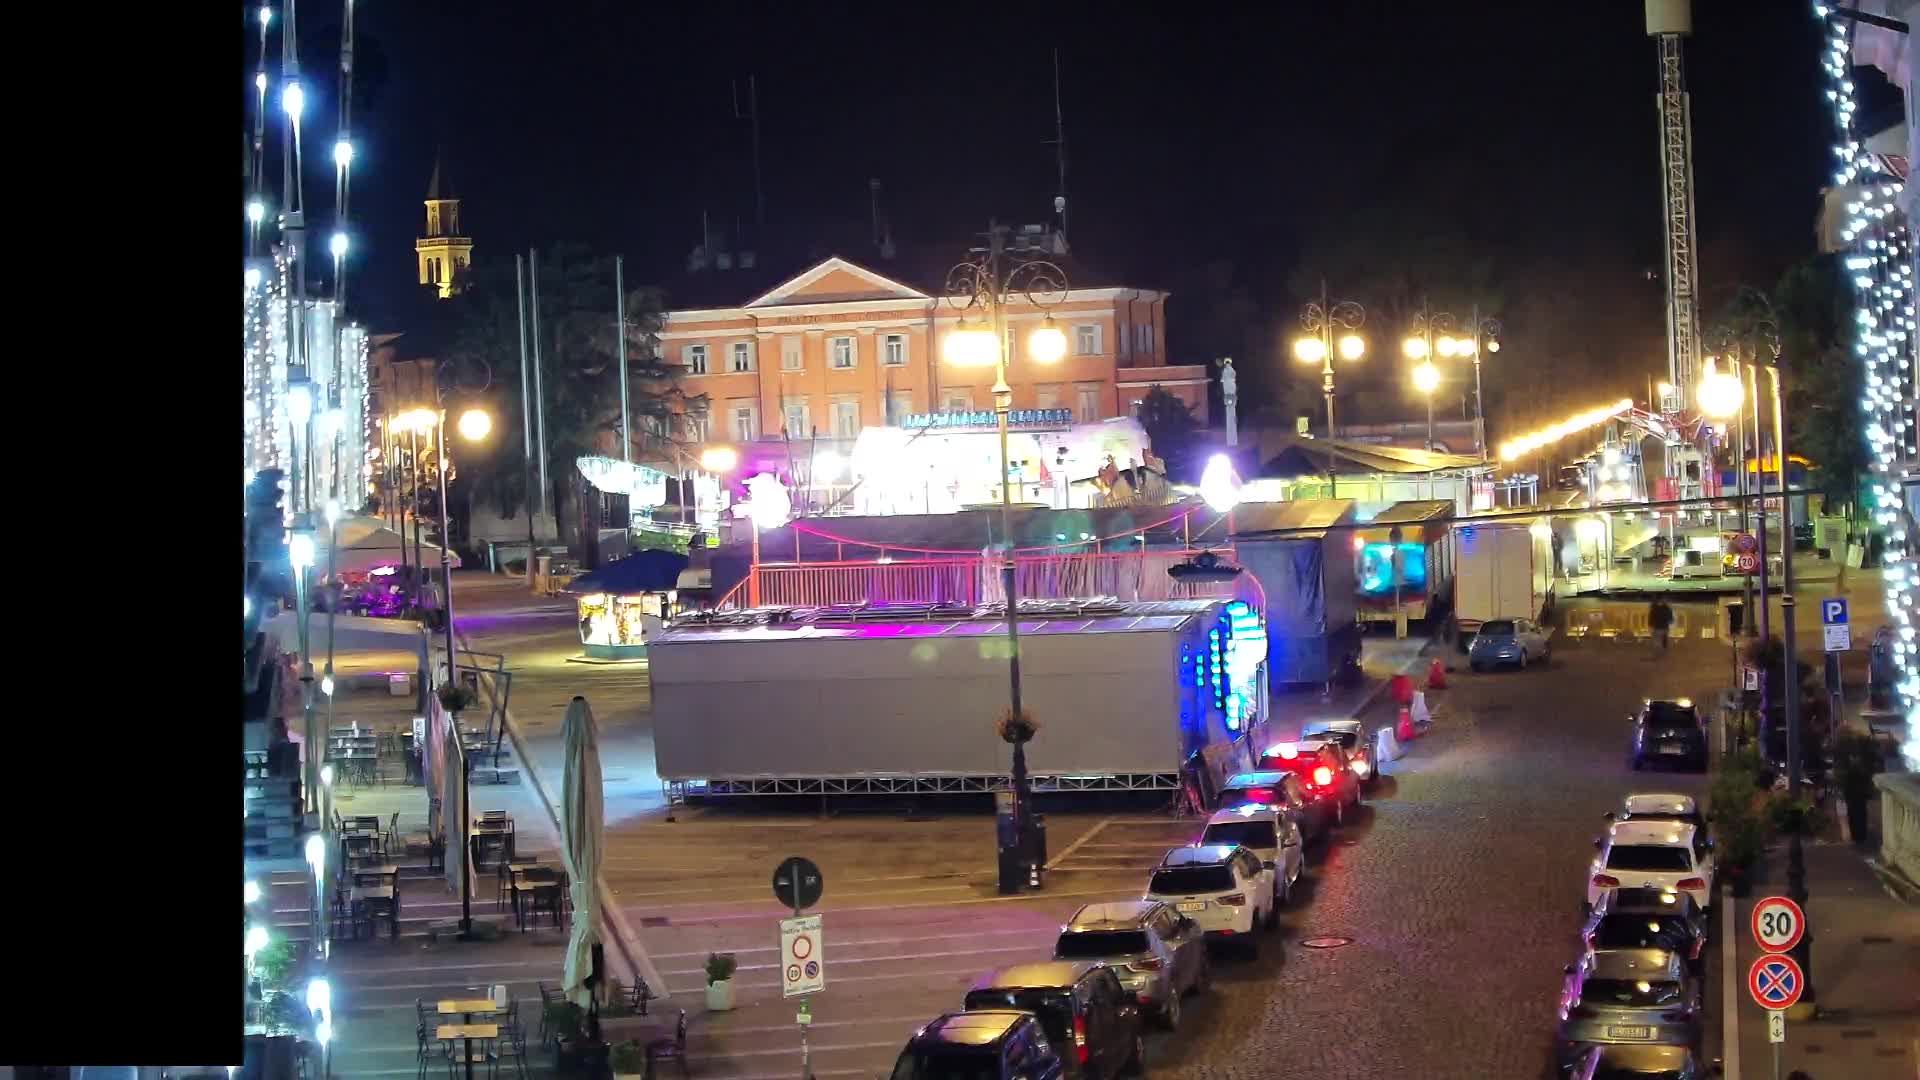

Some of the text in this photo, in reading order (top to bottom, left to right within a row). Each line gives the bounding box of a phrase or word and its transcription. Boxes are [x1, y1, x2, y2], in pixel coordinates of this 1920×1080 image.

[1742, 557, 1753, 567] 20
[1827, 602, 1842, 622] P
[1762, 912, 1792, 938] 30
